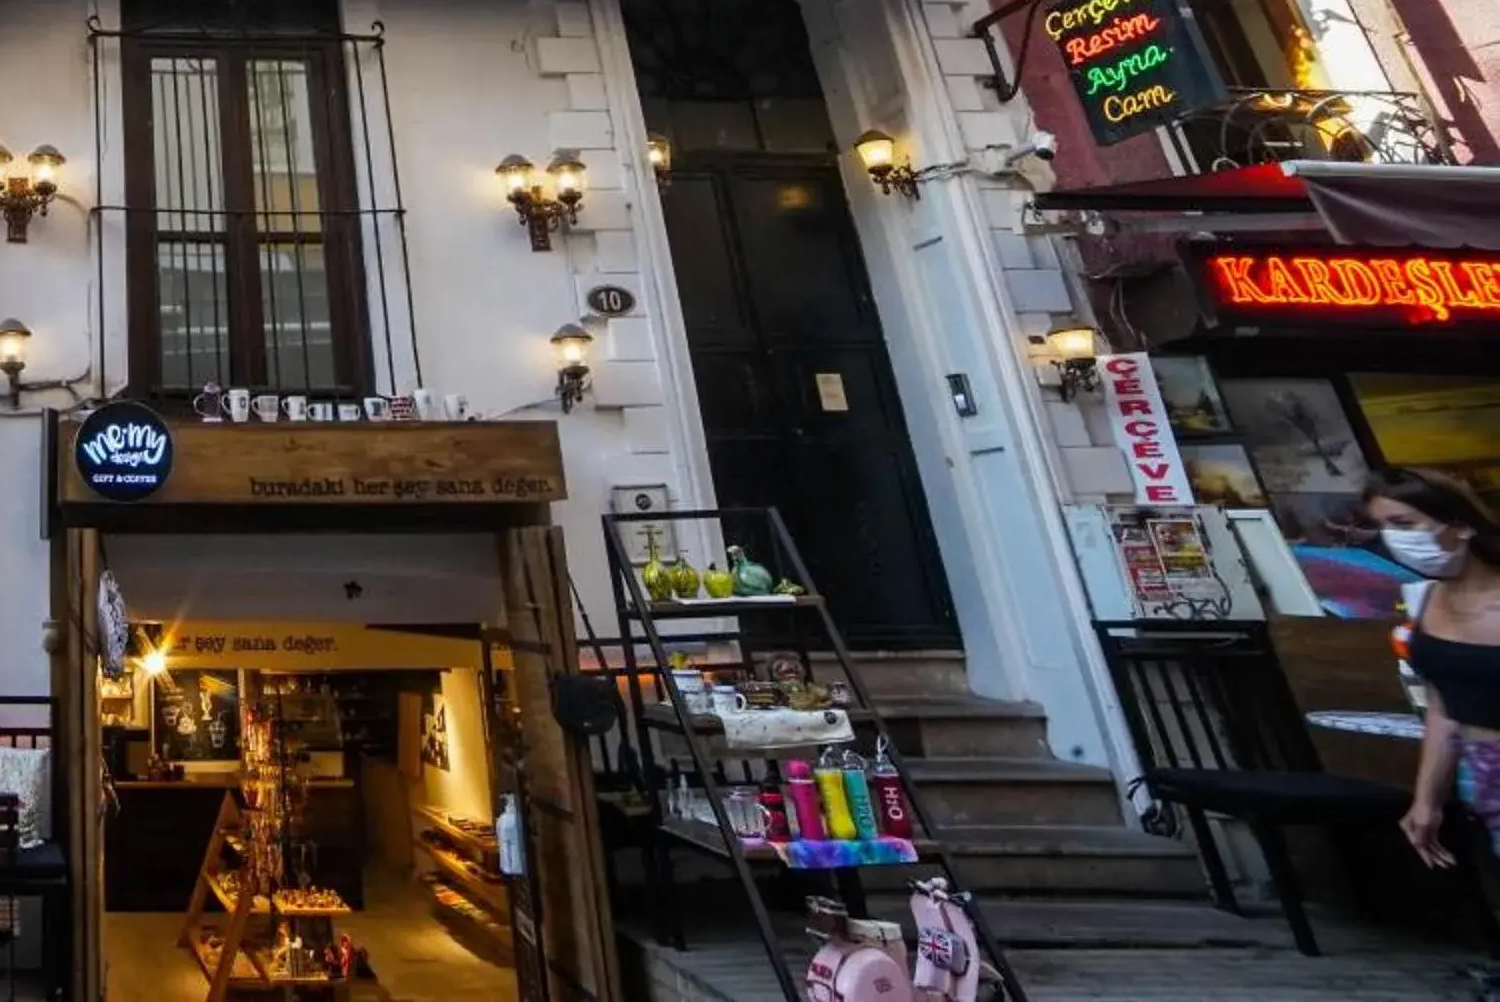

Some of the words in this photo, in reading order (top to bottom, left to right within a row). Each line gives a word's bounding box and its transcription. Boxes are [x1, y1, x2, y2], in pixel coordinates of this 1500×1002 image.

[1066, 13, 1159, 65] Resim
[1087, 45, 1168, 95] Ayna
[1103, 84, 1175, 122] Cam
[598, 290, 621, 311] 10
[1216, 257, 1500, 321] KARDEŞLE
[250, 477, 345, 497] buradaki
[353, 478, 389, 496] her
[436, 478, 486, 495] sana
